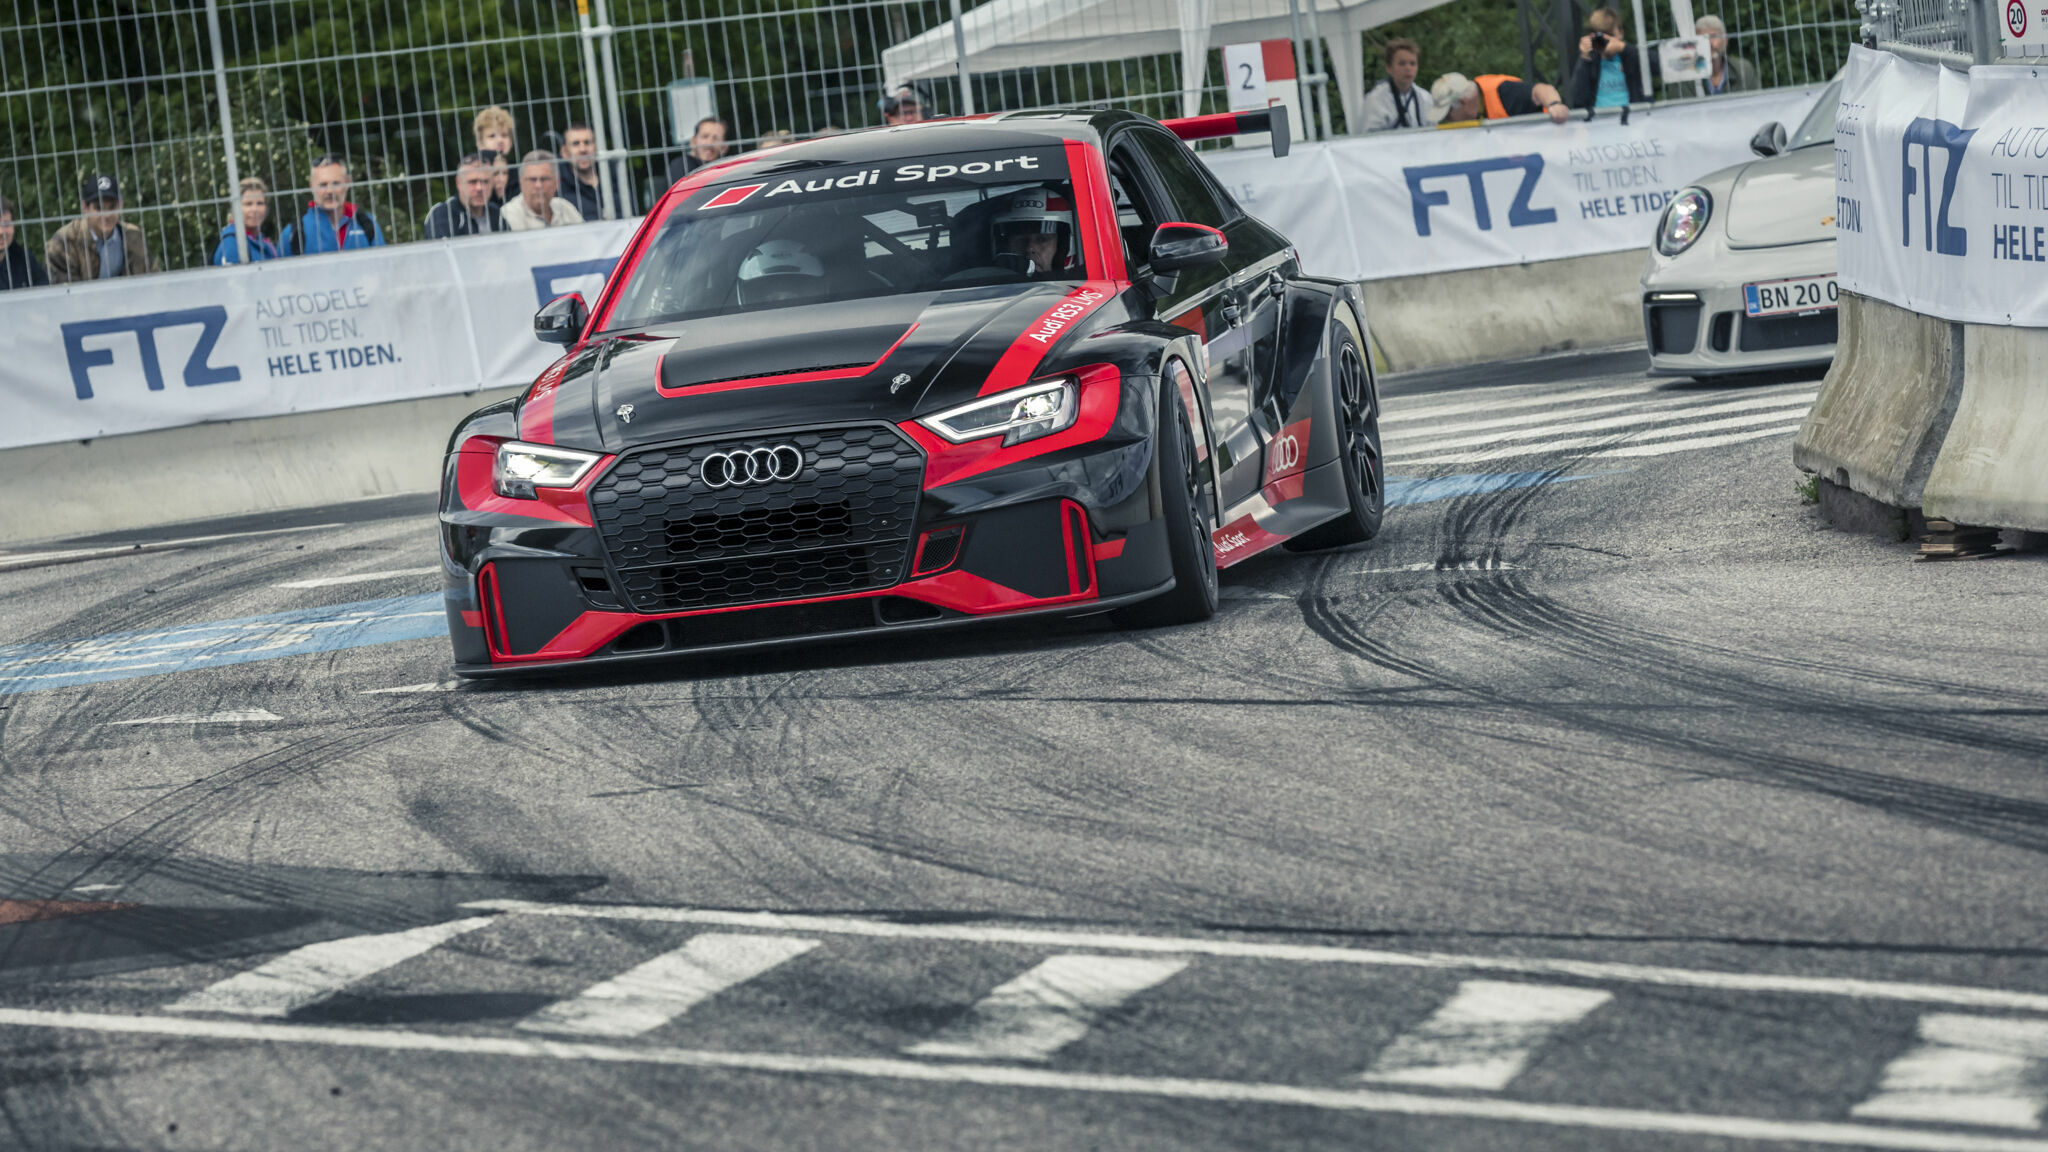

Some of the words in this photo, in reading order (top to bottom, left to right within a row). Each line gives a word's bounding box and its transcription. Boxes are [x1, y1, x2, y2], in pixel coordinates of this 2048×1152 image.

[2010, 8, 2023, 24] 20
[1239, 63, 1255, 90] 2
[1568, 138, 1666, 166] AUTODELE
[764, 168, 881, 198] Audi
[894, 154, 1039, 182] Sport
[1572, 172, 1600, 192] TIL
[1602, 165, 1662, 189] TIDEN.
[1902, 116, 1980, 257] FTZ
[1991, 172, 2019, 209] TIL
[1402, 152, 1557, 237] FTZ
[1580, 196, 1627, 219] HELE
[1630, 190, 1679, 213] TIDE
[1993, 223, 2046, 262] HELE
[256, 286, 369, 320] AUTODELE
[1760, 287, 1790, 310] BN
[1793, 283, 1821, 306] 20
[1827, 280, 1839, 303] 0
[260, 326, 292, 349] TIL
[293, 317, 364, 344] TIDEN.
[1029, 318, 1066, 344] Audi
[1050, 303, 1084, 320] RS3
[1070, 290, 1103, 306] LMS
[60, 305, 241, 400] FTZ
[267, 351, 322, 377] HELE
[325, 342, 402, 371] TIDEN.
